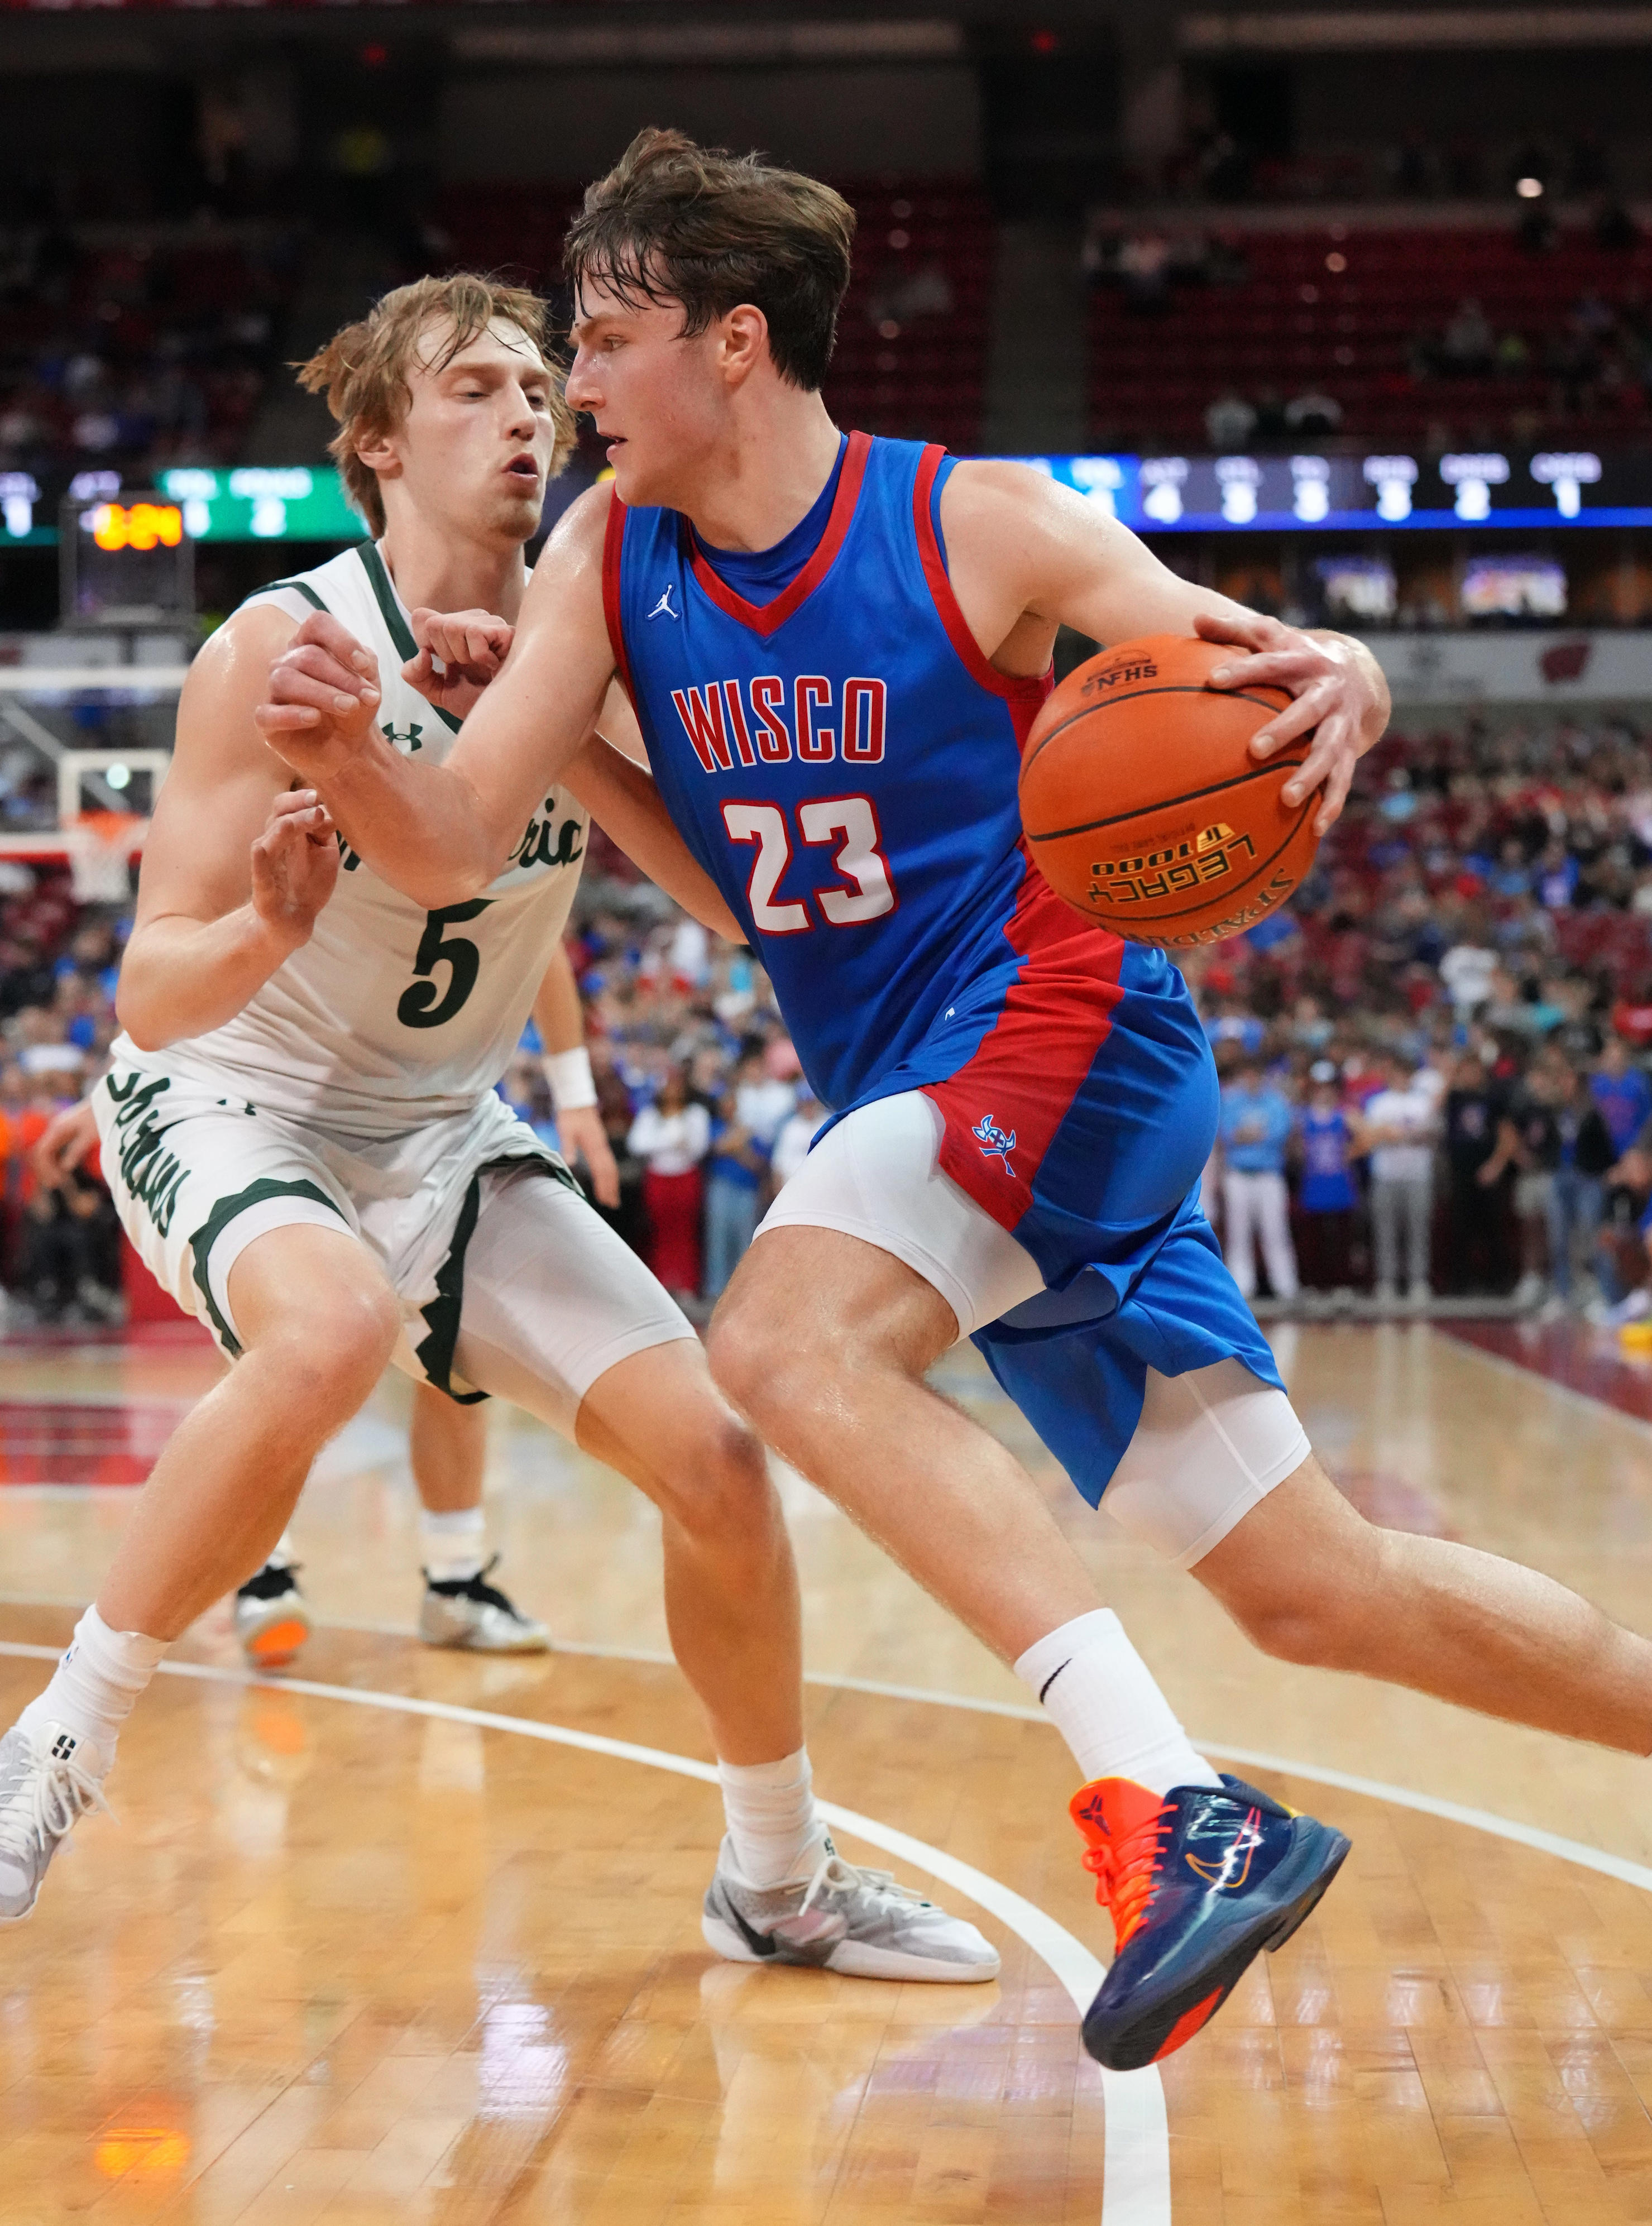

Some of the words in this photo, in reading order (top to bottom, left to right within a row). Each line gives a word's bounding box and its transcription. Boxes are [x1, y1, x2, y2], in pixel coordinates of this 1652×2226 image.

[1097, 665, 1158, 691] NFHS
[670, 675, 887, 774] WISCO
[719, 792, 900, 937] 23
[1086, 832, 1257, 904] LEGACY
[1090, 841, 1194, 877] 1000
[397, 898, 500, 1028] 5
